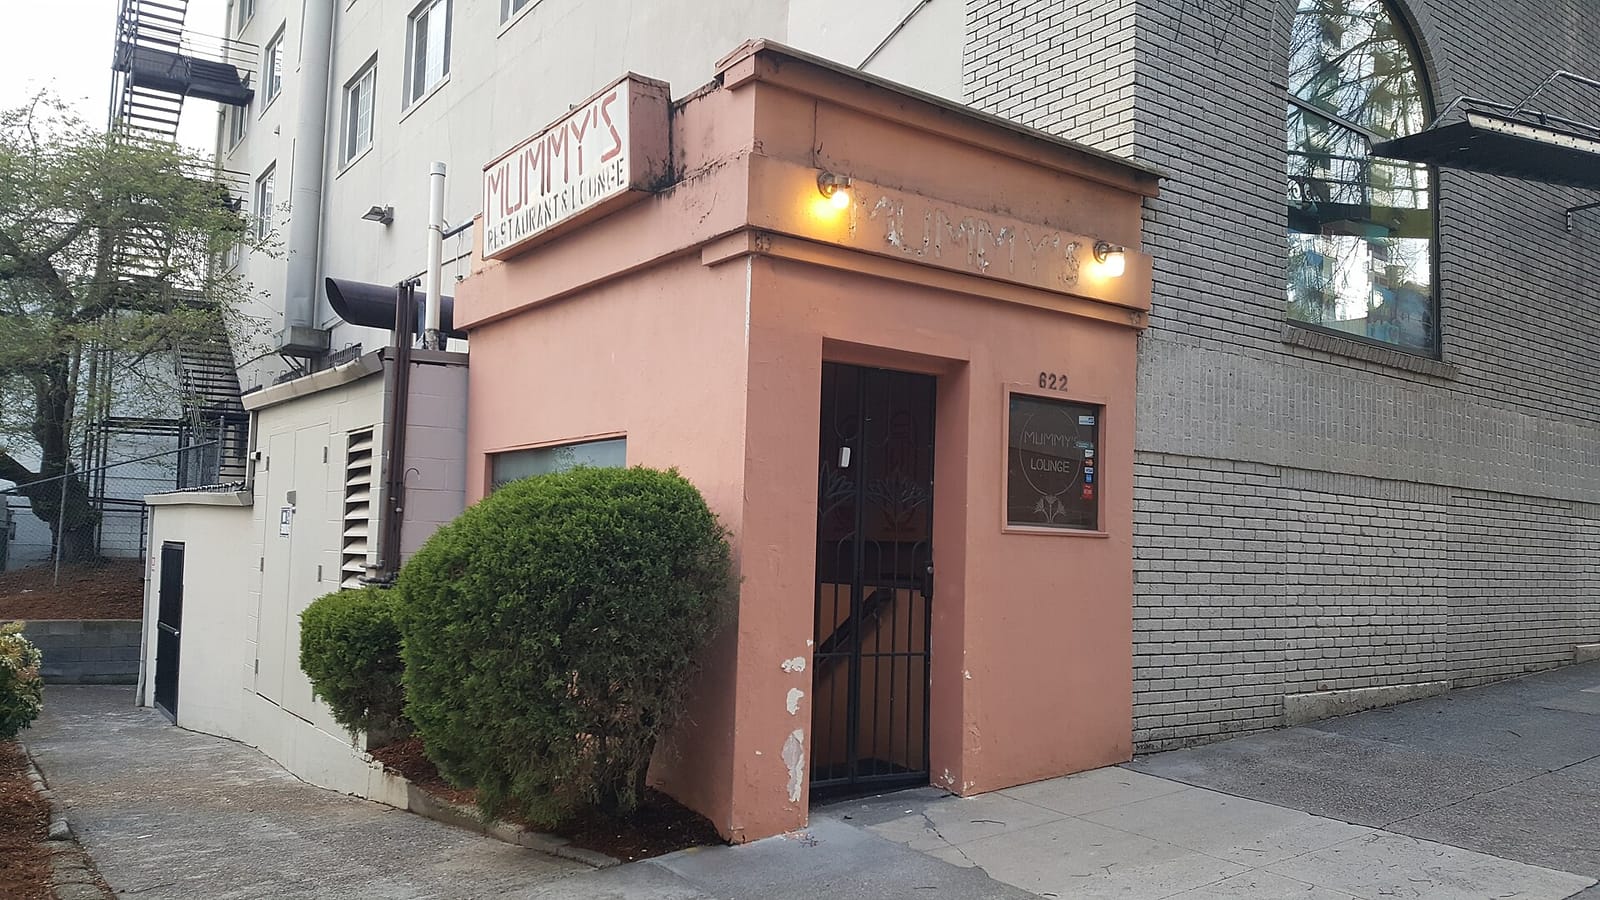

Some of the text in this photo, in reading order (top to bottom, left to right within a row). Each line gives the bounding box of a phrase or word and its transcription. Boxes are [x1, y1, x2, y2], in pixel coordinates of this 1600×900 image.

[487, 91, 622, 227] MUMMY'S
[1039, 372, 1068, 391] 622
[1030, 457, 1070, 473] LOUNGE
